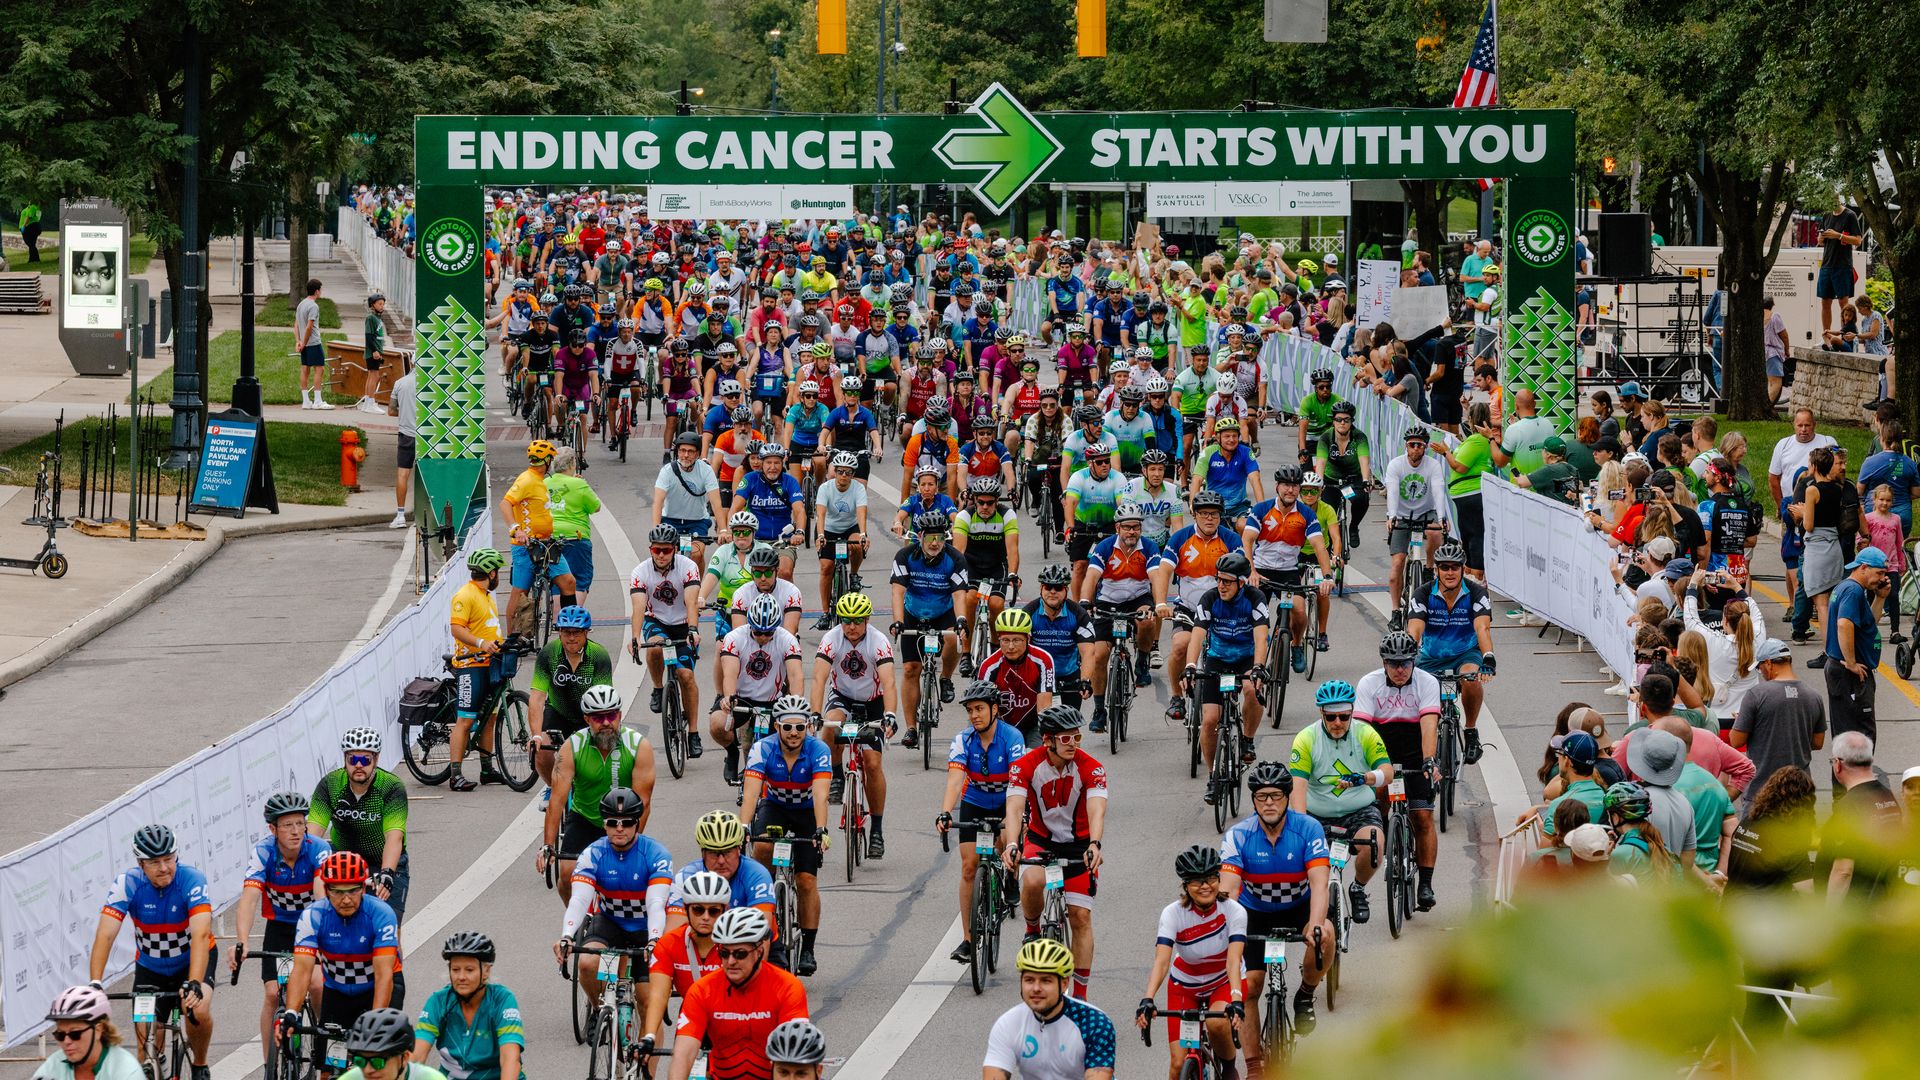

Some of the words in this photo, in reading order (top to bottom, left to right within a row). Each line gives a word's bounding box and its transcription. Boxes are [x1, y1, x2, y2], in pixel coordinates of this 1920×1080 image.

[448, 130, 660, 170] ENDING
[675, 130, 895, 169] CANCER
[1090, 128, 1277, 167] STARTS
[1286, 126, 1423, 165] WITH
[1435, 124, 1547, 163] YOU
[802, 199, 846, 210] Huntington
[1228, 193, 1268, 204] VS&Co
[1520, 215, 1563, 232] PELOTONIA
[428, 222, 471, 241] PELOTONIA
[1517, 235, 1540, 262] ENDING
[1542, 234, 1566, 262] CANCER
[426, 243, 449, 270] ENDING
[451, 243, 475, 270] CANCER
[1374, 283, 1383, 306] Team
[1358, 294, 1372, 325] Thank
[210, 438, 234, 446] NORTH
[209, 445, 228, 453] BANK
[229, 447, 247, 455] PARK
[207, 452, 239, 461] PAVILION
[207, 459, 229, 467] EVENT
[205, 469, 226, 477] GUEST
[203, 476, 232, 485] PARKING
[202, 483, 220, 491] ONLY
[1140, 500, 1171, 514] MVP
[463, 673, 472, 708] NOCTERRA
[104, 907, 123, 920] GOAL
[294, 947, 314, 955] GOAL
[713, 1011, 771, 1021] GERMAIN
